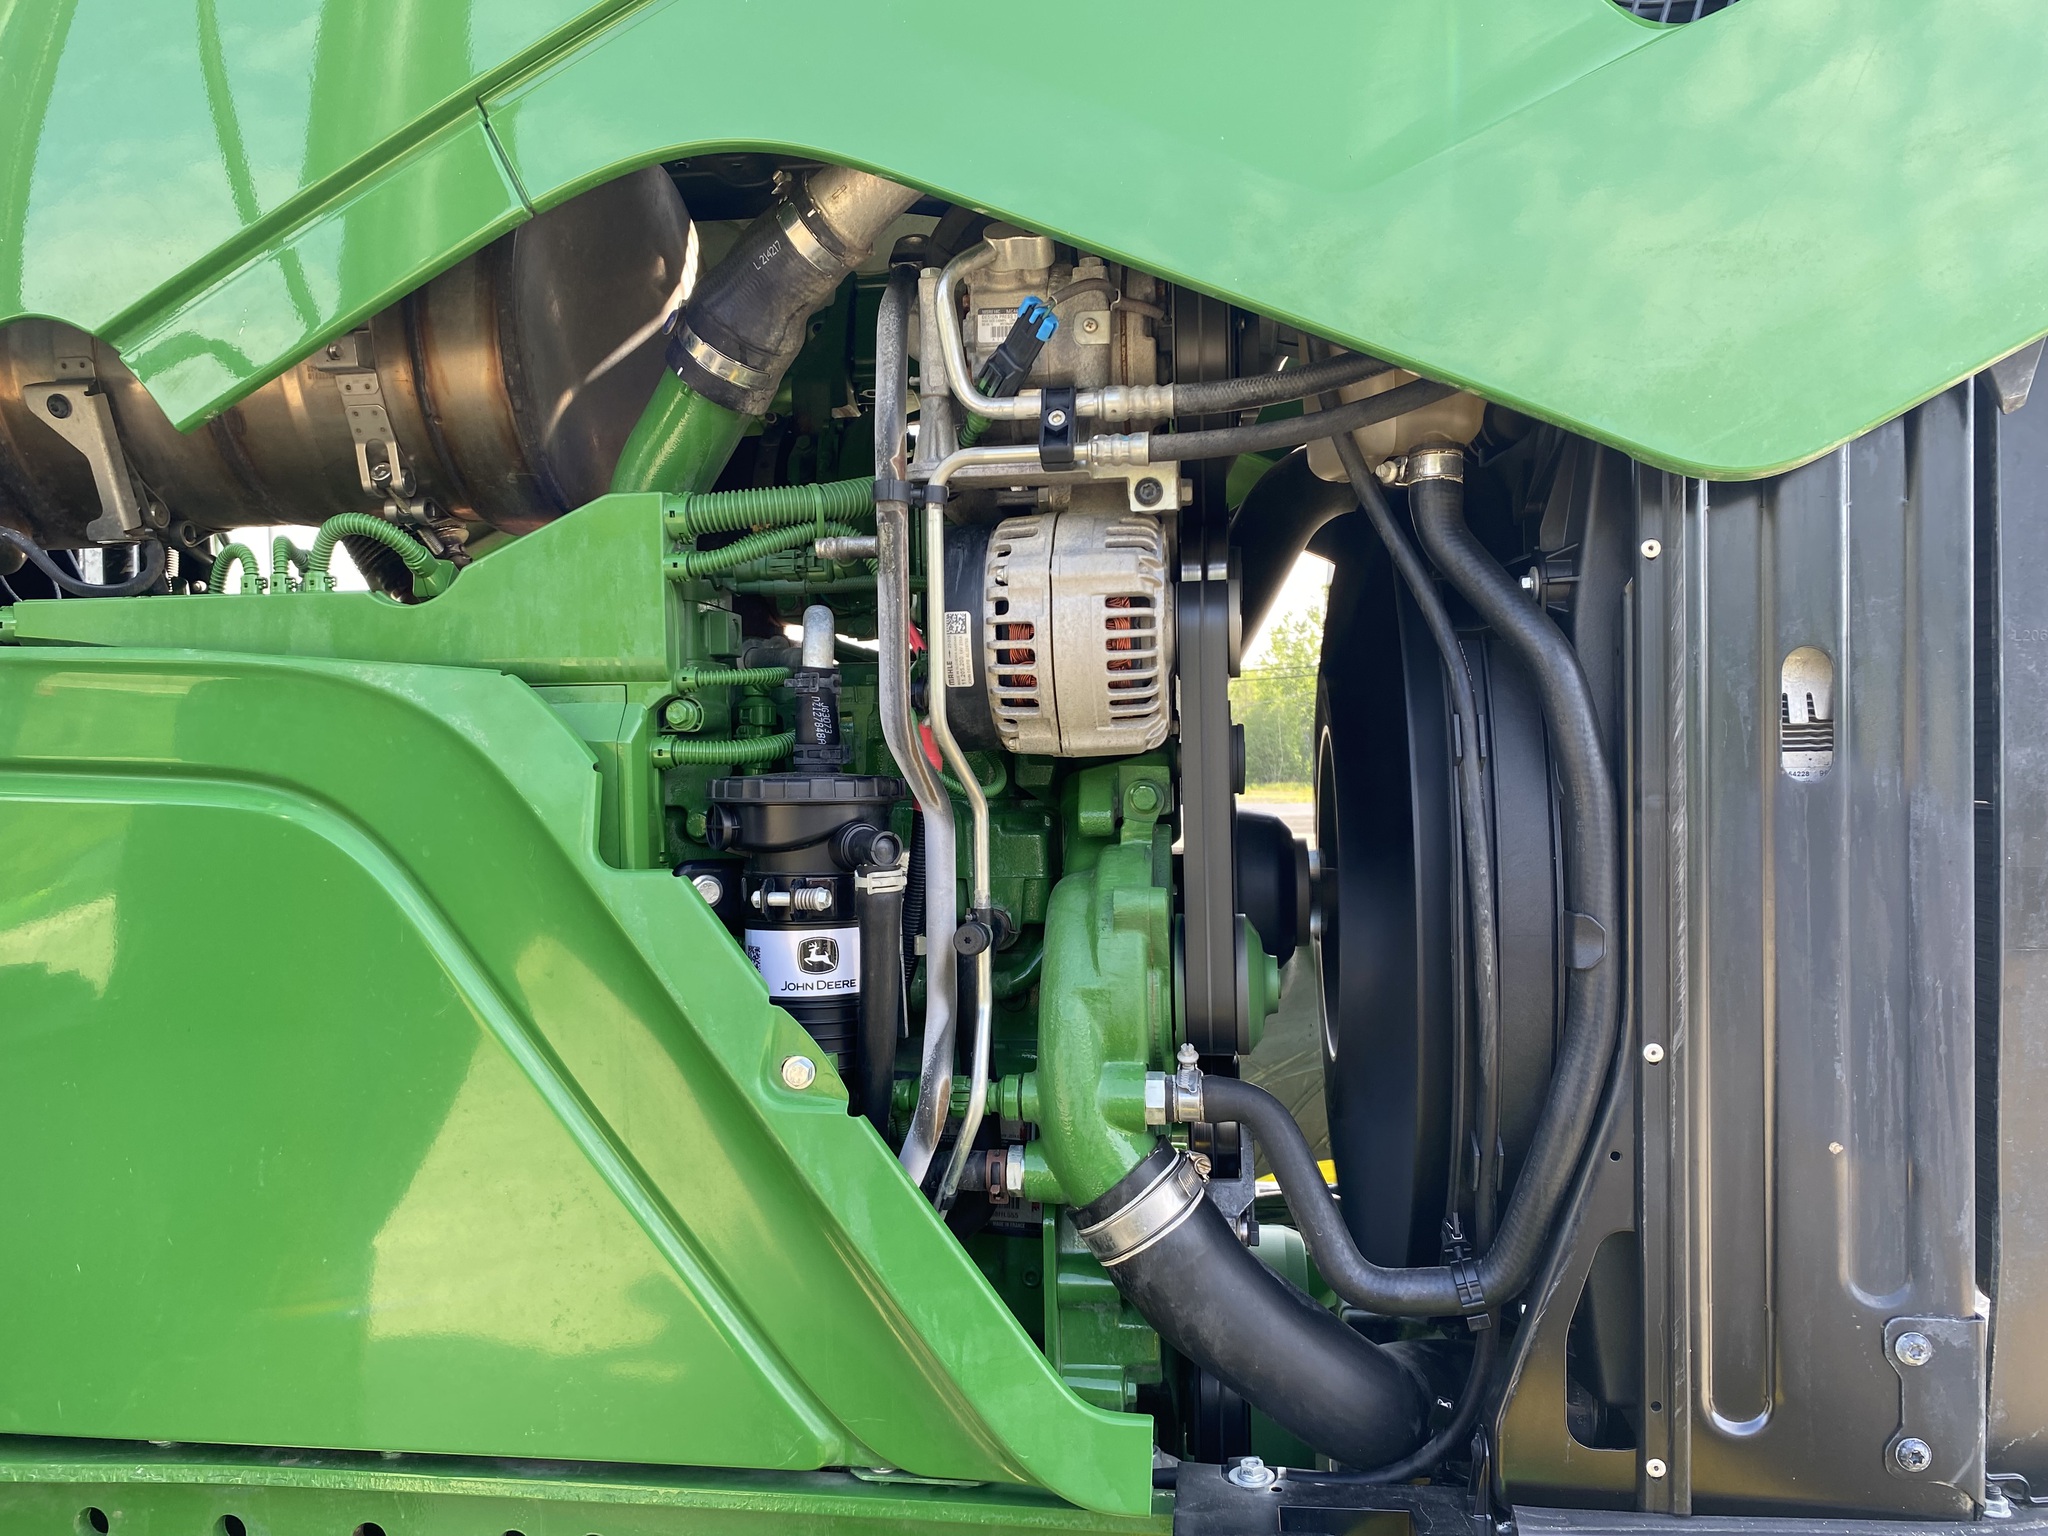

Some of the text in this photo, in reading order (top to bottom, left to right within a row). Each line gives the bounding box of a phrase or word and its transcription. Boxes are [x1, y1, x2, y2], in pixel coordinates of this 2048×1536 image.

[752, 239, 782, 271] L 214217
[946, 661, 955, 686] MAHLE
[820, 702, 833, 735] JG3073
[781, 978, 857, 992] JOHN DEERE
